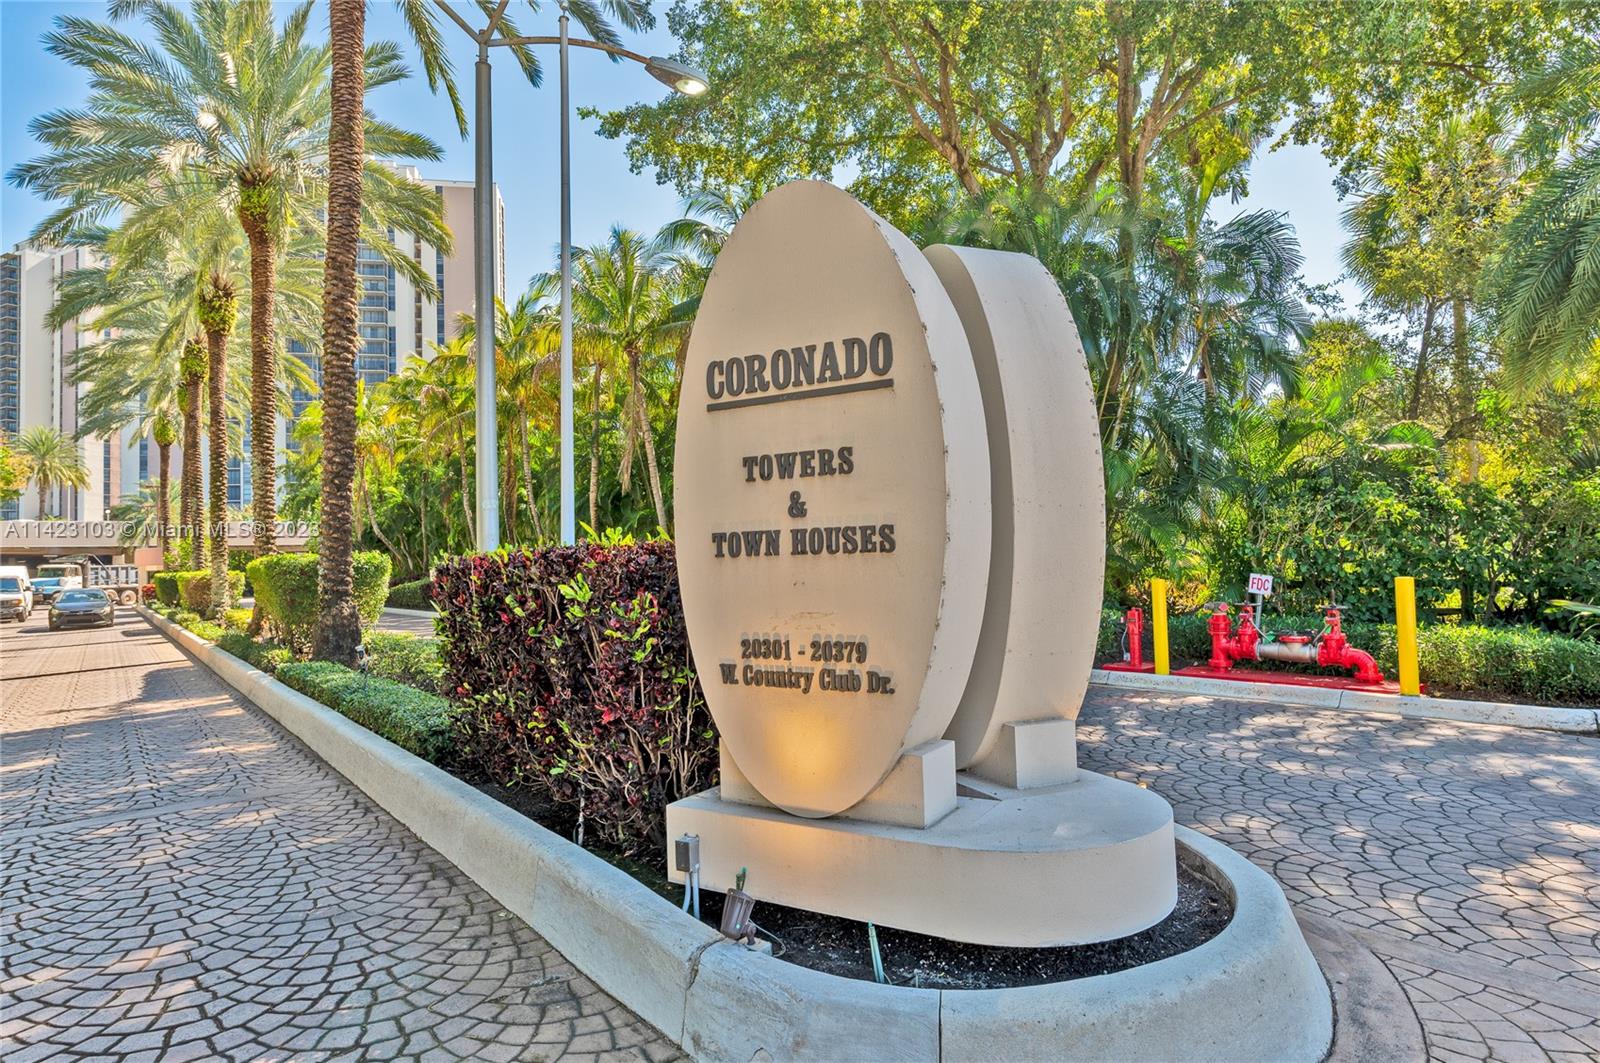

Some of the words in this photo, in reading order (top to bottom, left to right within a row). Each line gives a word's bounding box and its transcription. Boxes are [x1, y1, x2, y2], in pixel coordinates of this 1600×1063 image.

[706, 332, 894, 400] CORONADO
[742, 446, 854, 482] TOWERS
[787, 490, 807, 518] &
[711, 529, 780, 557] TOWN
[790, 524, 896, 555] HOUSES
[1250, 577, 1270, 592] FDC
[740, 638, 792, 661] 20301
[810, 640, 868, 664] 20379
[719, 663, 739, 685] W.
[742, 664, 815, 694] Country
[819, 668, 862, 692] Club
[867, 671, 896, 695] Dr.
